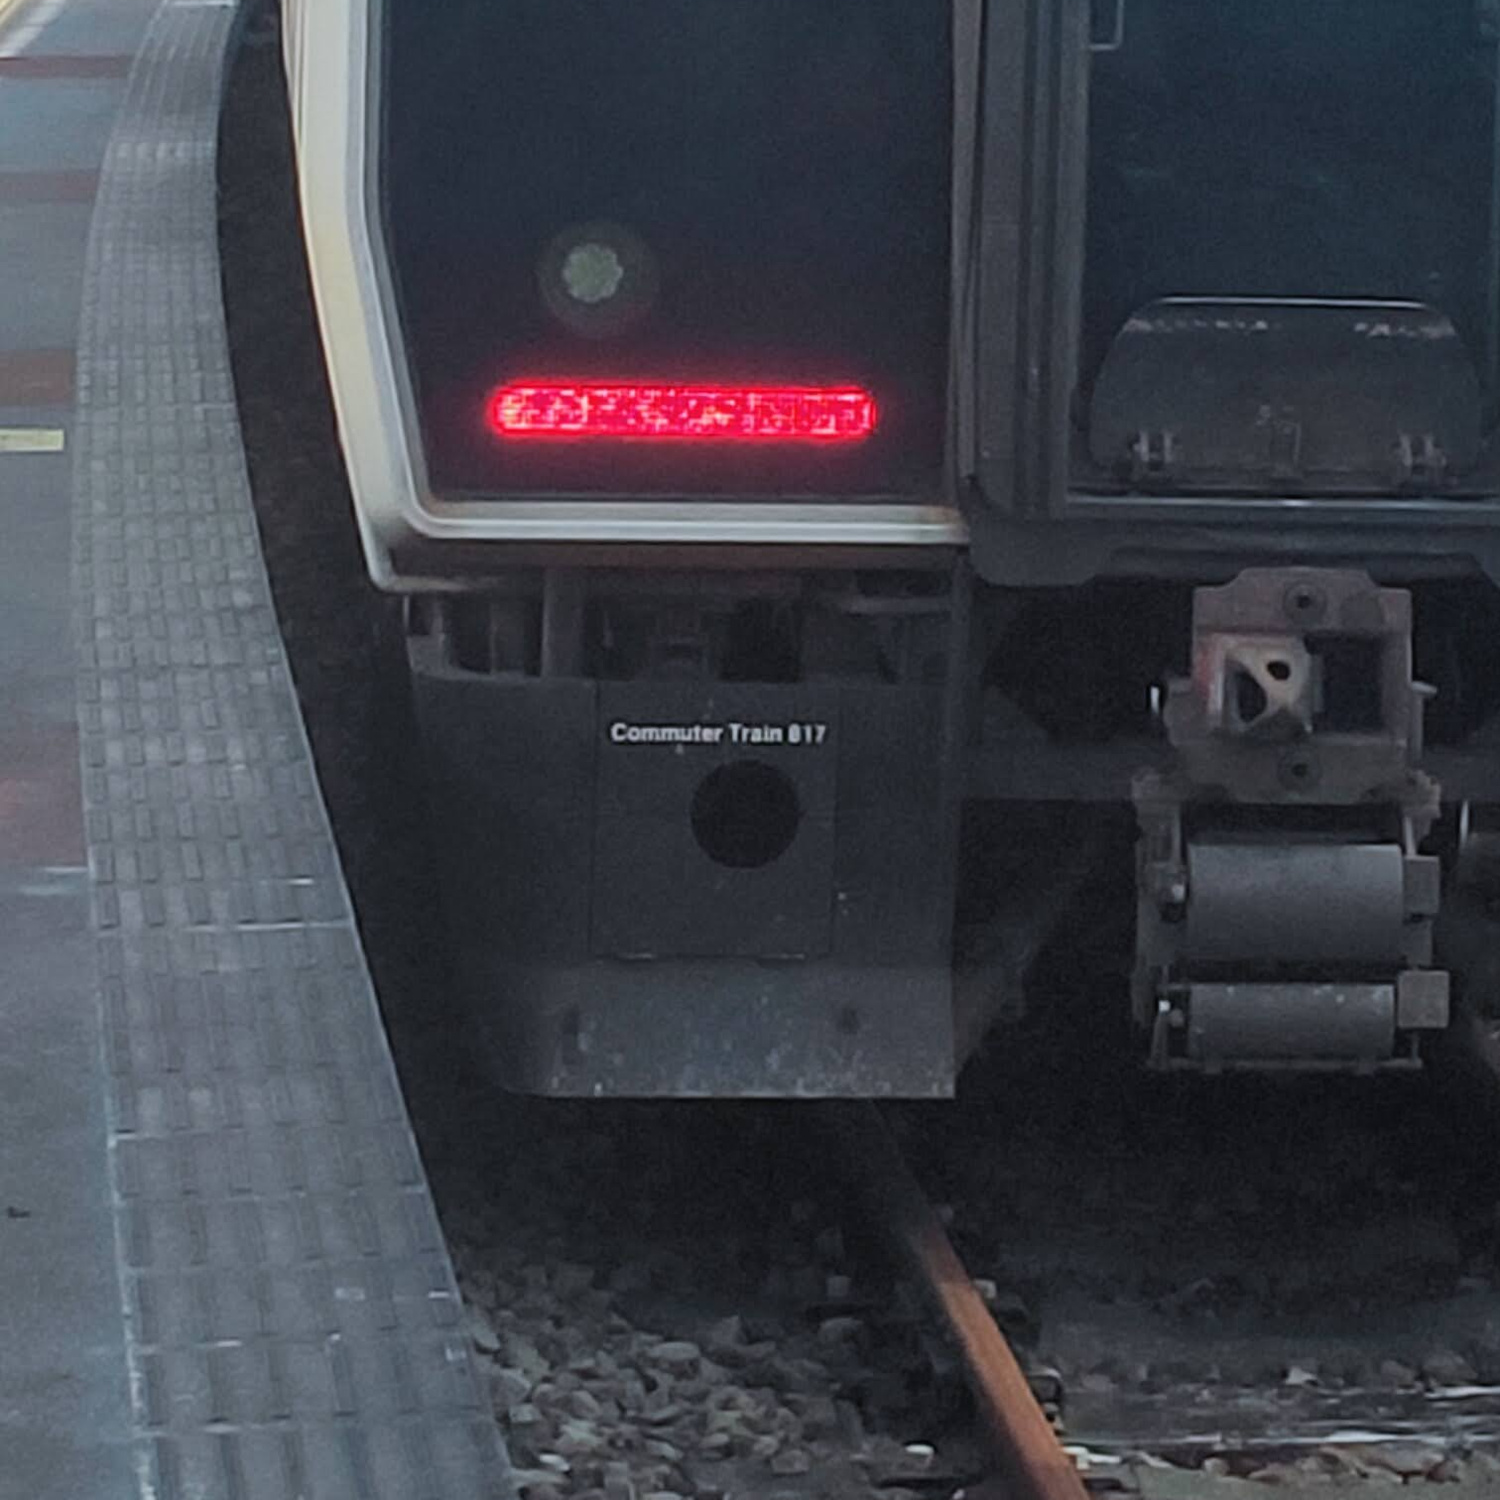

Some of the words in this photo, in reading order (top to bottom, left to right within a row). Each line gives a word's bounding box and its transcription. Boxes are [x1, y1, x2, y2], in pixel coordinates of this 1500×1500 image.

[610, 722, 723, 743] Commuter
[728, 723, 783, 743] Train
[787, 723, 827, 744] 817
